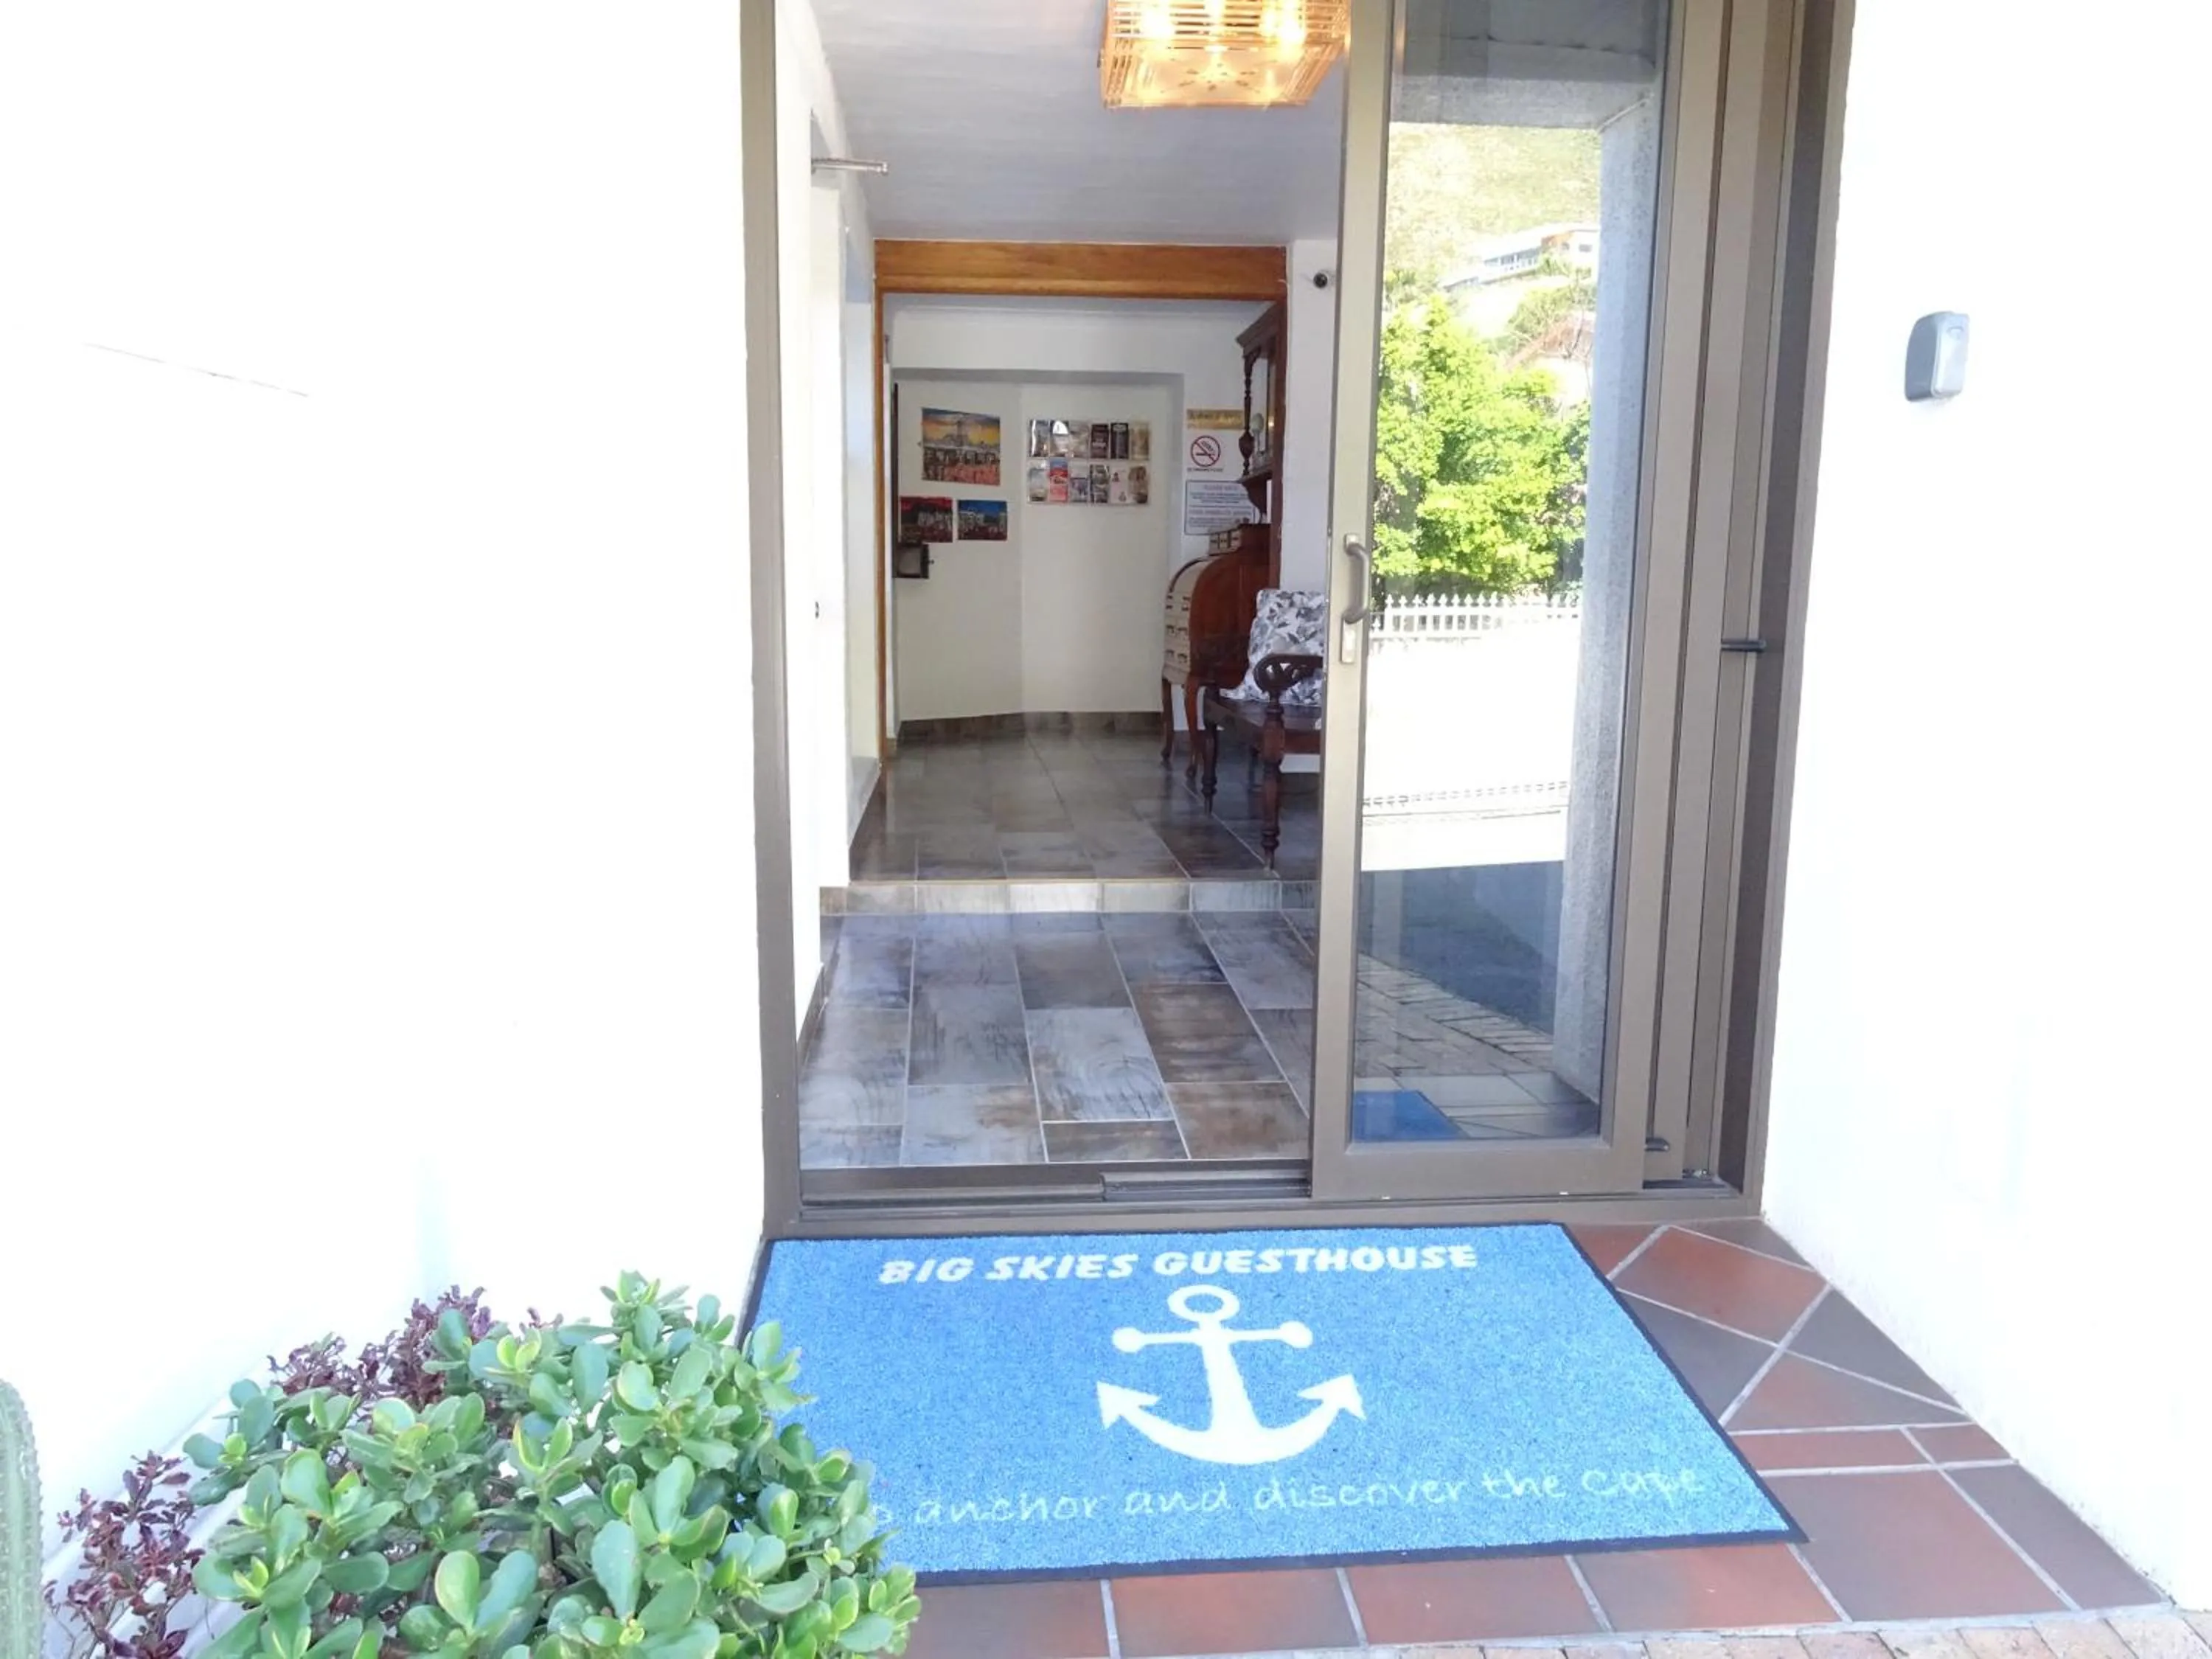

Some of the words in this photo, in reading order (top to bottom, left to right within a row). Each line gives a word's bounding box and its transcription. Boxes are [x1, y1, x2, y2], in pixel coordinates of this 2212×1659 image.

[878, 1257, 973, 1284] BIG
[984, 1253, 1138, 1281] SKIES
[1152, 1246, 1478, 1276] GUESTHOUSE
[914, 1491, 1108, 1525] anchor
[1123, 1478, 1232, 1516] and
[1254, 1477, 1467, 1510] discover
[1482, 1467, 1565, 1498] the
